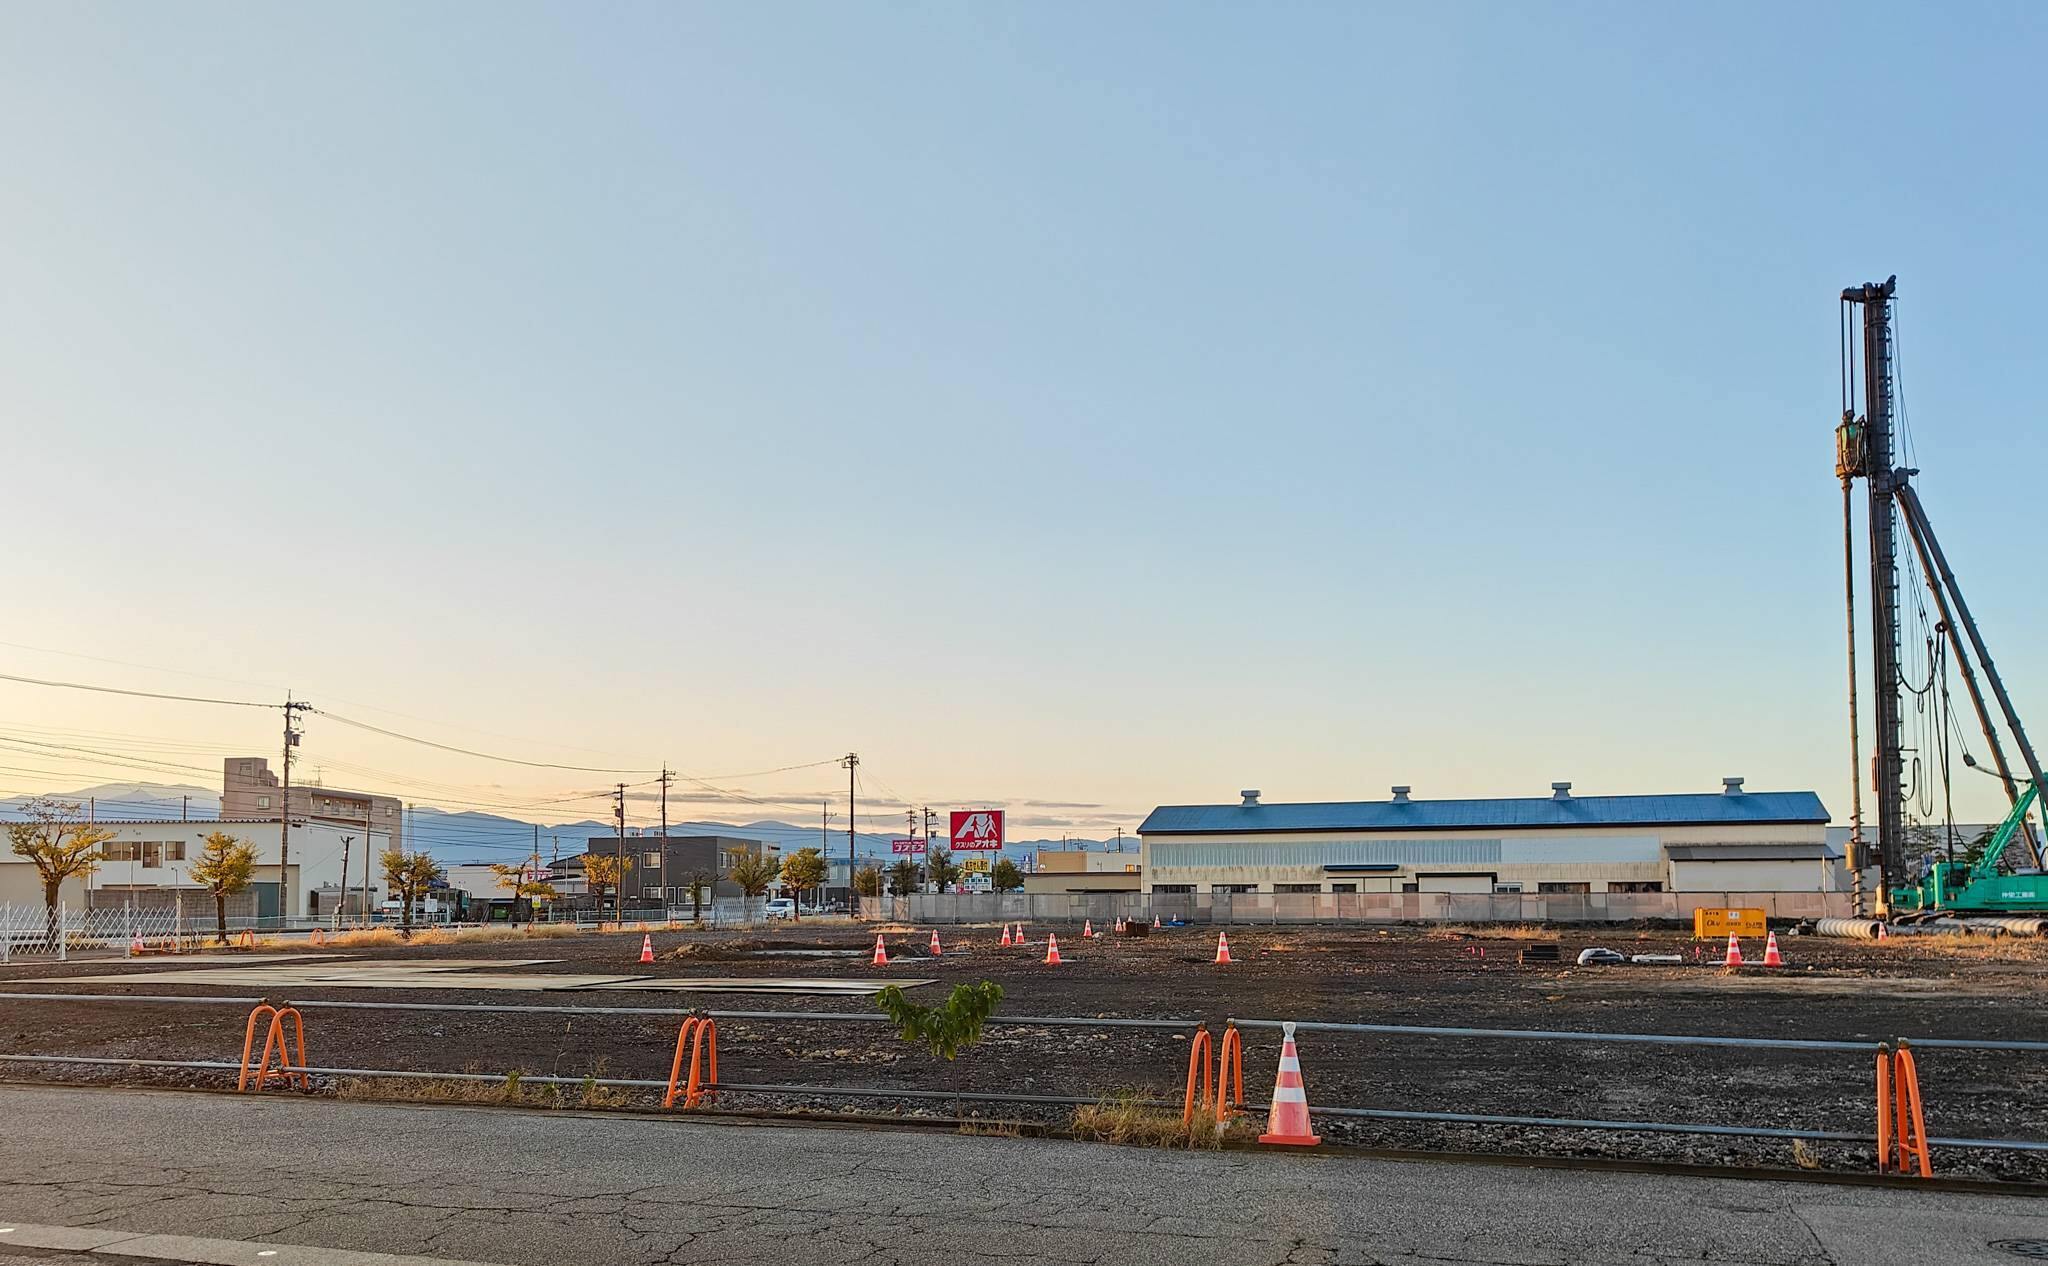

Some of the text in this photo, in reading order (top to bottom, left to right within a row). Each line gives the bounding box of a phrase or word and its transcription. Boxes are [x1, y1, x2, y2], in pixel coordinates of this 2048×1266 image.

[955, 839, 998, 848] クスリのアオキ
[894, 844, 925, 852] コスモス
